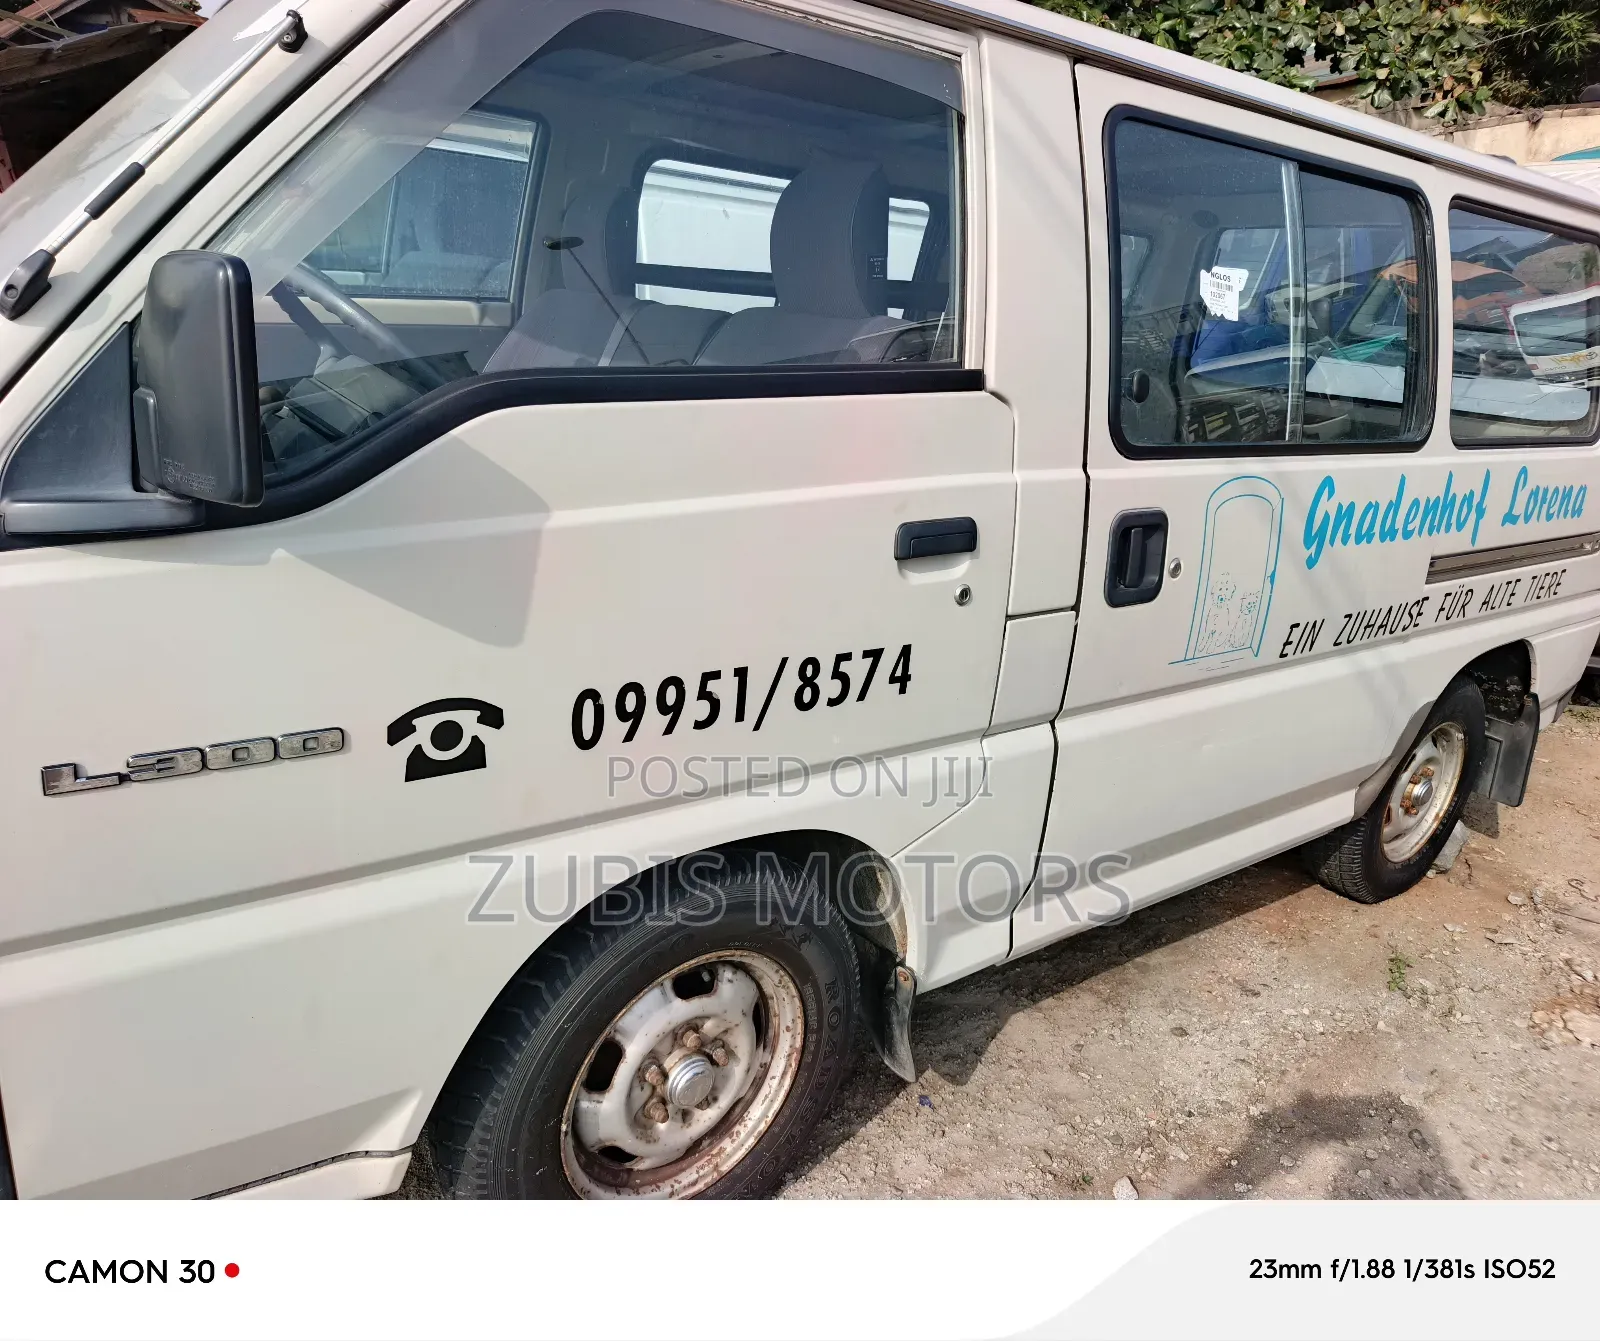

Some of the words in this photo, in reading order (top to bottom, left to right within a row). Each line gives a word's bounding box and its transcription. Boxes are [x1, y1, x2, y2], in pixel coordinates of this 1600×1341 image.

[1303, 468, 1490, 570] Gnadenhof
[1501, 465, 1588, 527] Lorena
[1279, 618, 1325, 659] EIN
[1333, 597, 1429, 647] ZUHAUSE
[1435, 585, 1474, 623] FÜR
[1478, 578, 1521, 613] ALTE
[1524, 569, 1567, 602] TIERE
[571, 644, 912, 751] 09951/8574
[40, 727, 345, 797] L300
